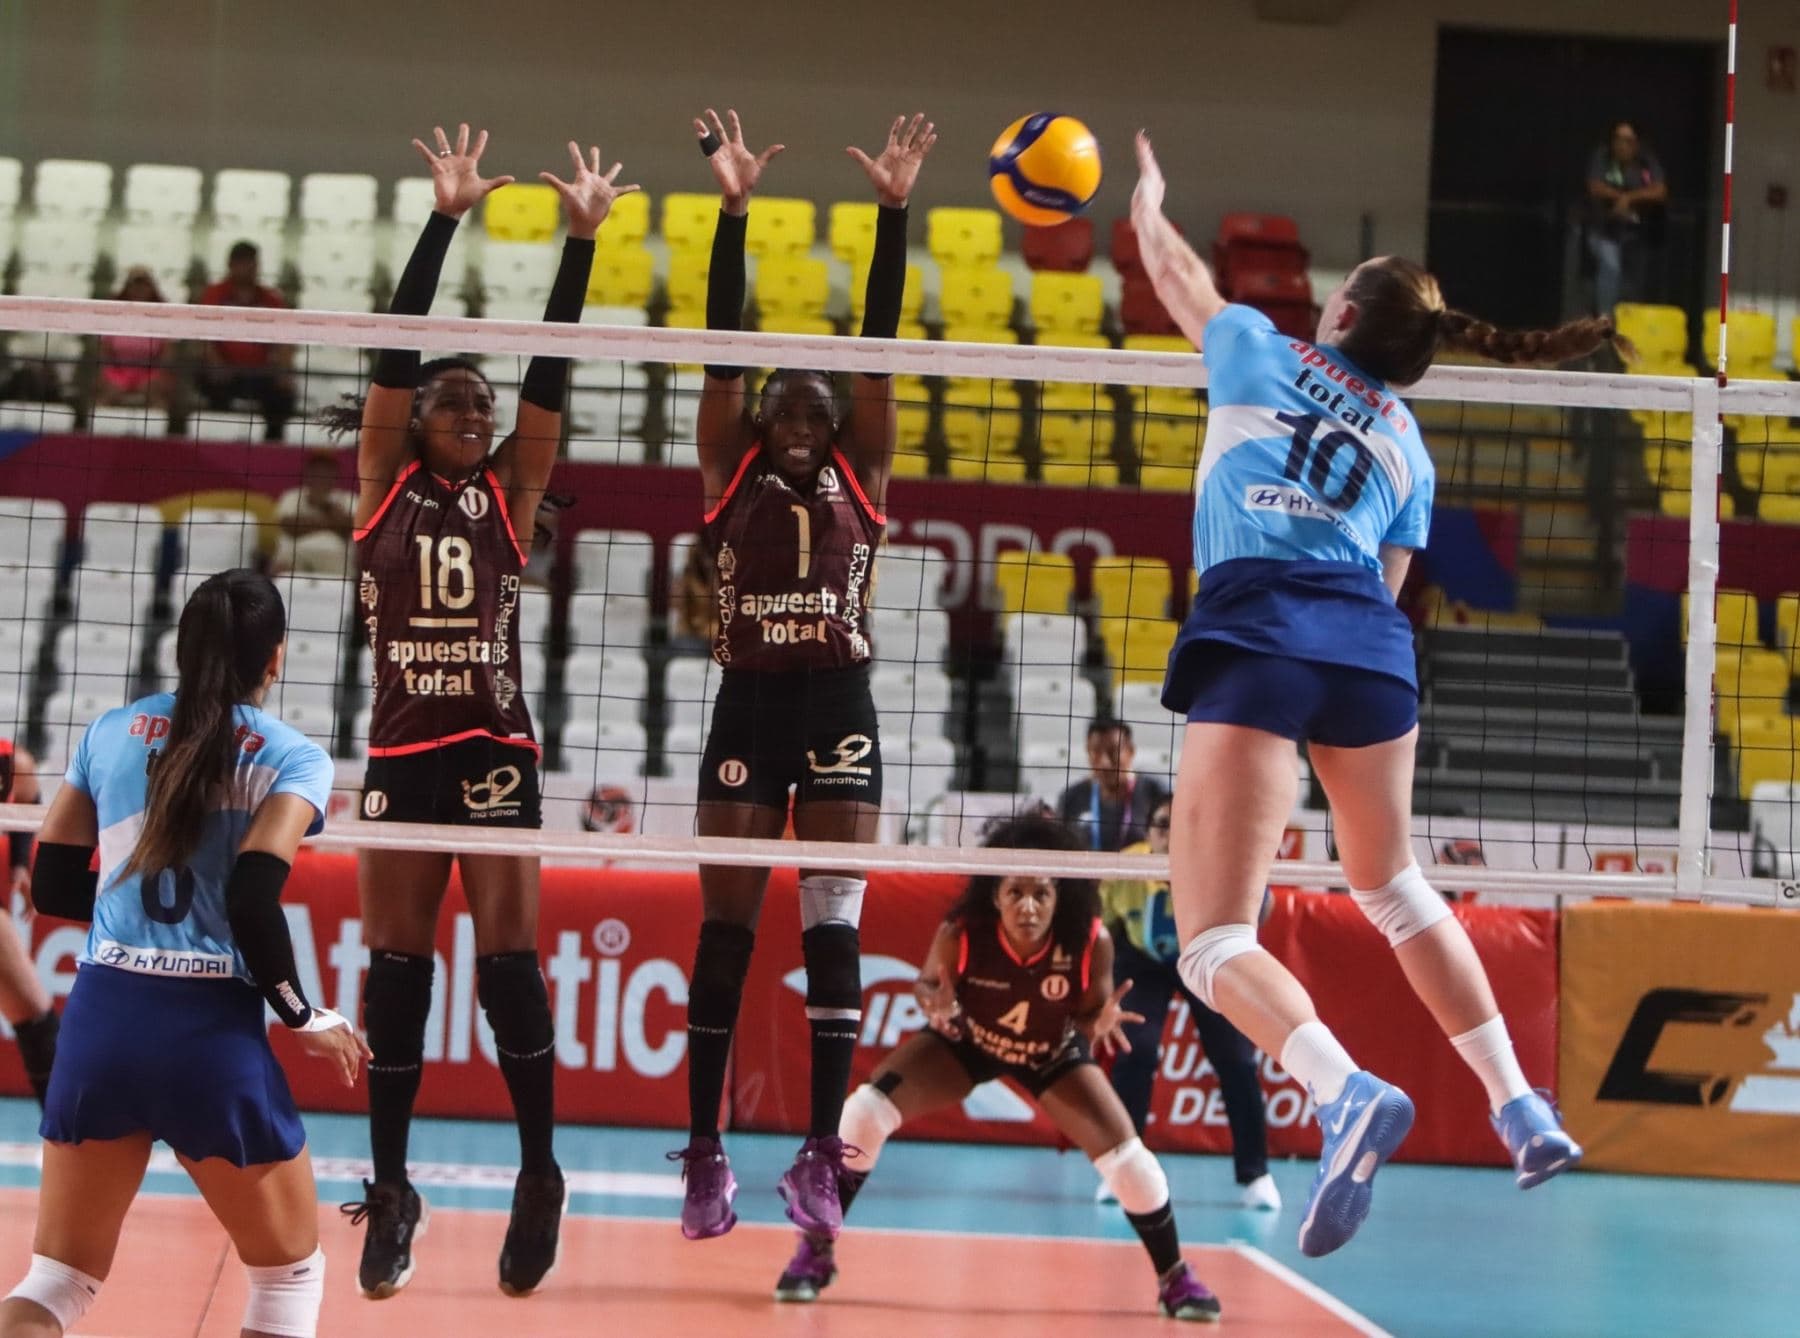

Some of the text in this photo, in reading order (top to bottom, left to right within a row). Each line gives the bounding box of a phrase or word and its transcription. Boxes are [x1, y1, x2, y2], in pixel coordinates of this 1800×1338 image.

[1290, 341, 1408, 434] apuesta
[1294, 367, 1377, 436] total
[1275, 411, 1373, 513] 10
[790, 504, 811, 579] 1
[415, 534, 475, 610] 18
[762, 618, 828, 644] total
[388, 636, 490, 669] apuesta
[404, 669, 475, 696] total
[722, 762, 744, 785] U
[813, 776, 869, 787] marathon
[367, 793, 387, 816] U
[134, 953, 227, 975] HYUNDAI
[998, 1001, 1030, 1036] 4
